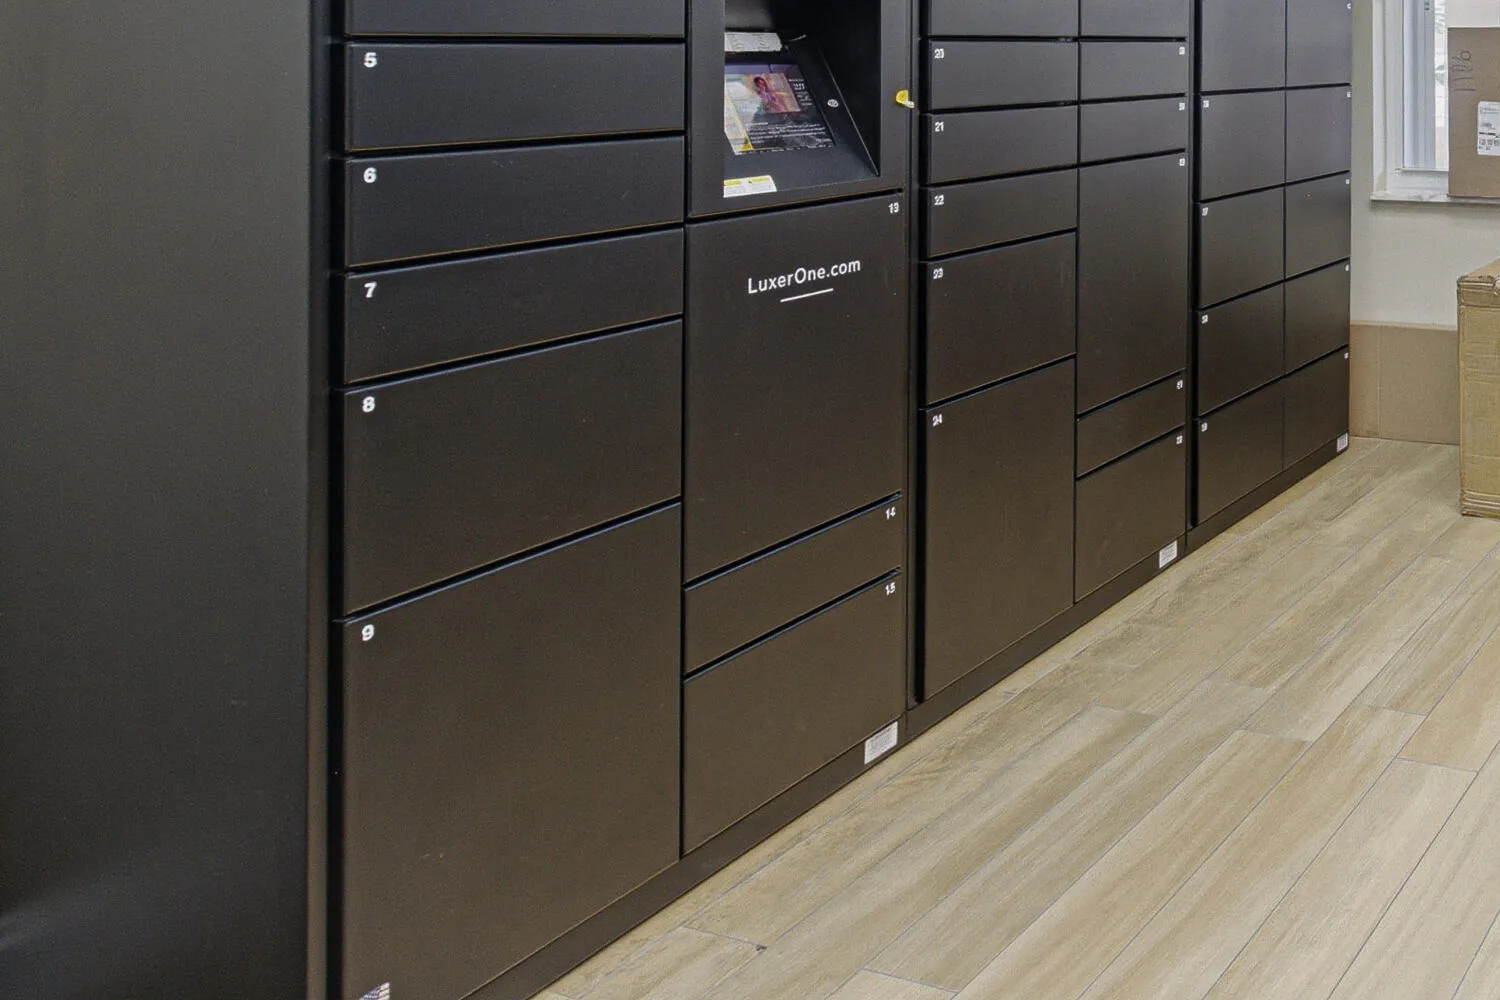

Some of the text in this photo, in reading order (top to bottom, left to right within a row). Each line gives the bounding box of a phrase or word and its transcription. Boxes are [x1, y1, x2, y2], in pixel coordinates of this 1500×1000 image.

[363, 52, 378, 68] 5
[363, 167, 377, 184] 6
[748, 258, 861, 294] LuxerOne.com
[364, 282, 377, 298] 7
[362, 396, 376, 413] 8
[361, 624, 375, 642] 9
